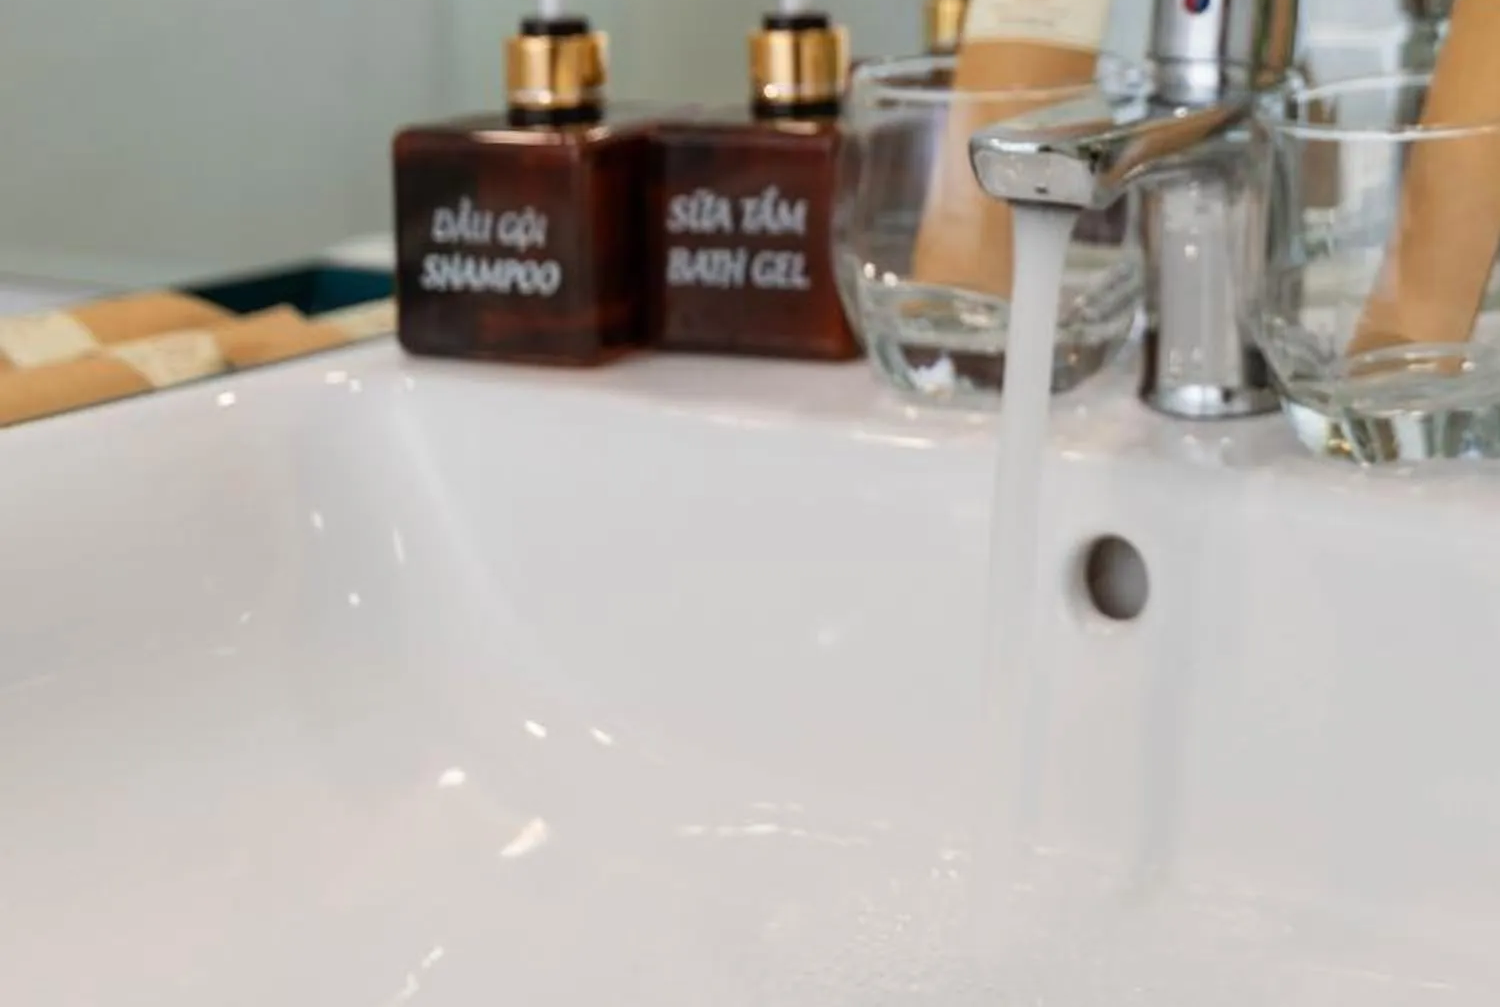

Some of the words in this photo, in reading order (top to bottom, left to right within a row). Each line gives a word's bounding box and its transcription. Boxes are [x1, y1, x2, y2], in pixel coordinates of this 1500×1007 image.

[420, 254, 560, 295] SHAMPOO
[667, 248, 746, 287] BATH
[751, 252, 809, 288] GEL
